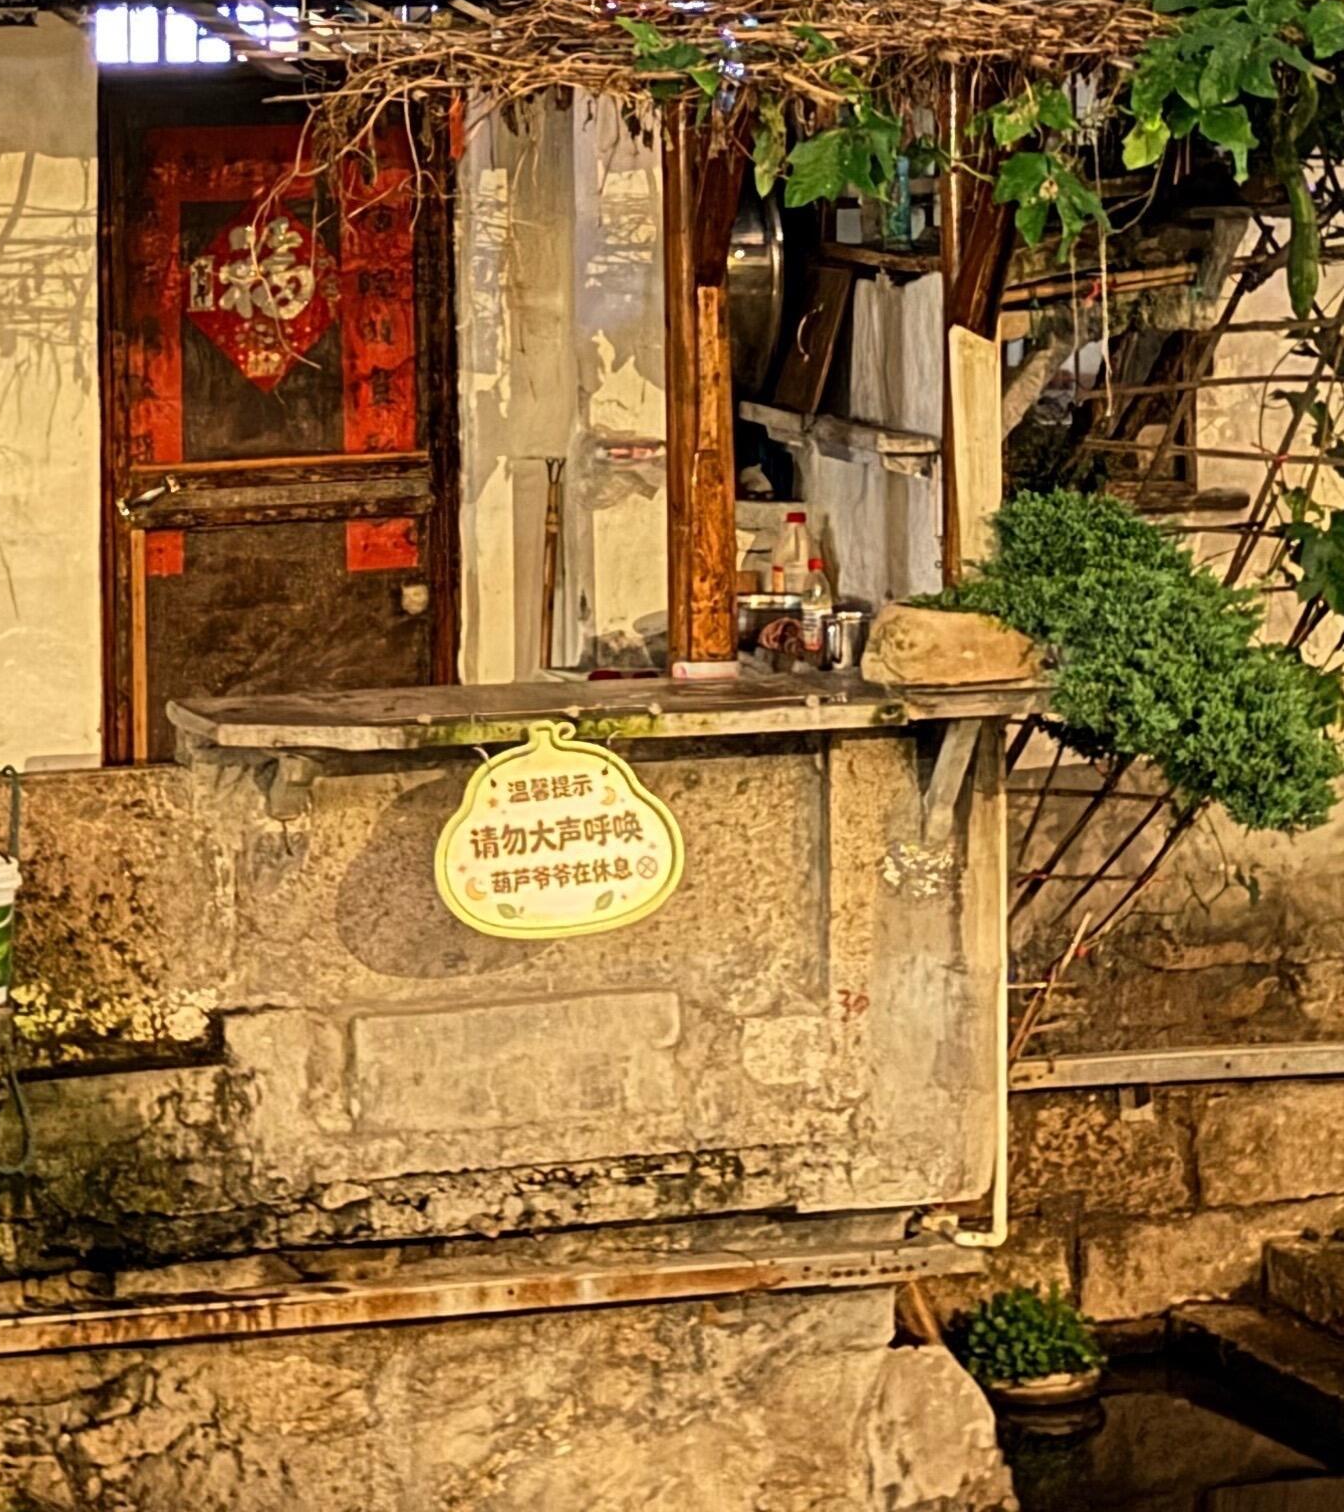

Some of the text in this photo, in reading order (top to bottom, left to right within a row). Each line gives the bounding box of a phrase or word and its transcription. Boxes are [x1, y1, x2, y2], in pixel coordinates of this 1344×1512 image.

[219, 217, 316, 320] 福
[508, 774, 593, 803] 温馨提示
[470, 810, 643, 859] 请勿大声呼唤
[491, 856, 632, 893] 葫芦爷爷在休息
